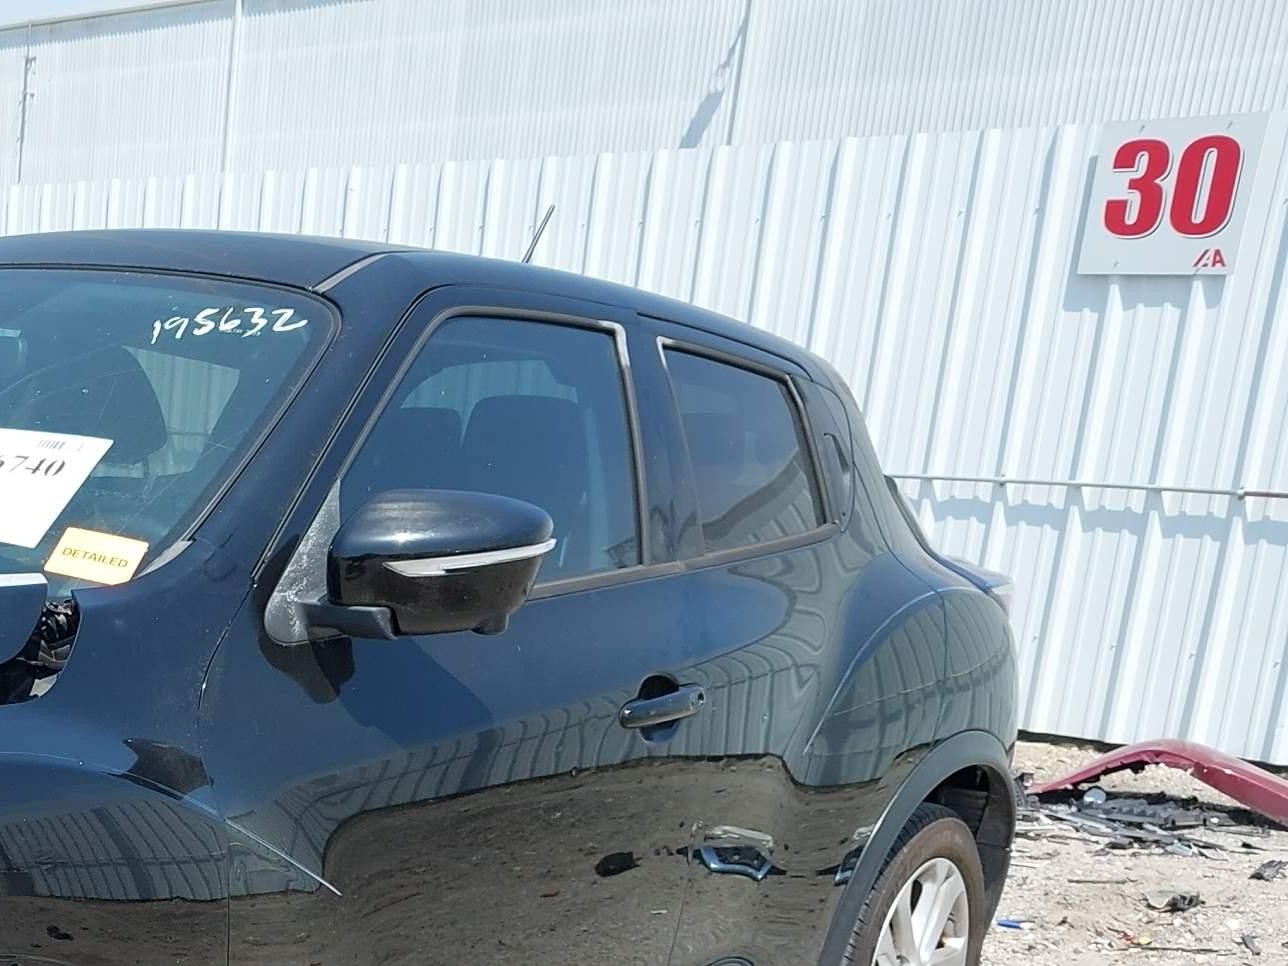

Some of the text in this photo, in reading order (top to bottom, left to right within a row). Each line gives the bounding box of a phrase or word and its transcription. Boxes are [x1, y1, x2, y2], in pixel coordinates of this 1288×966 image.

[1103, 134, 1244, 239] 30
[150, 306, 309, 345] 195632
[62, 547, 128, 568] DETAILED
